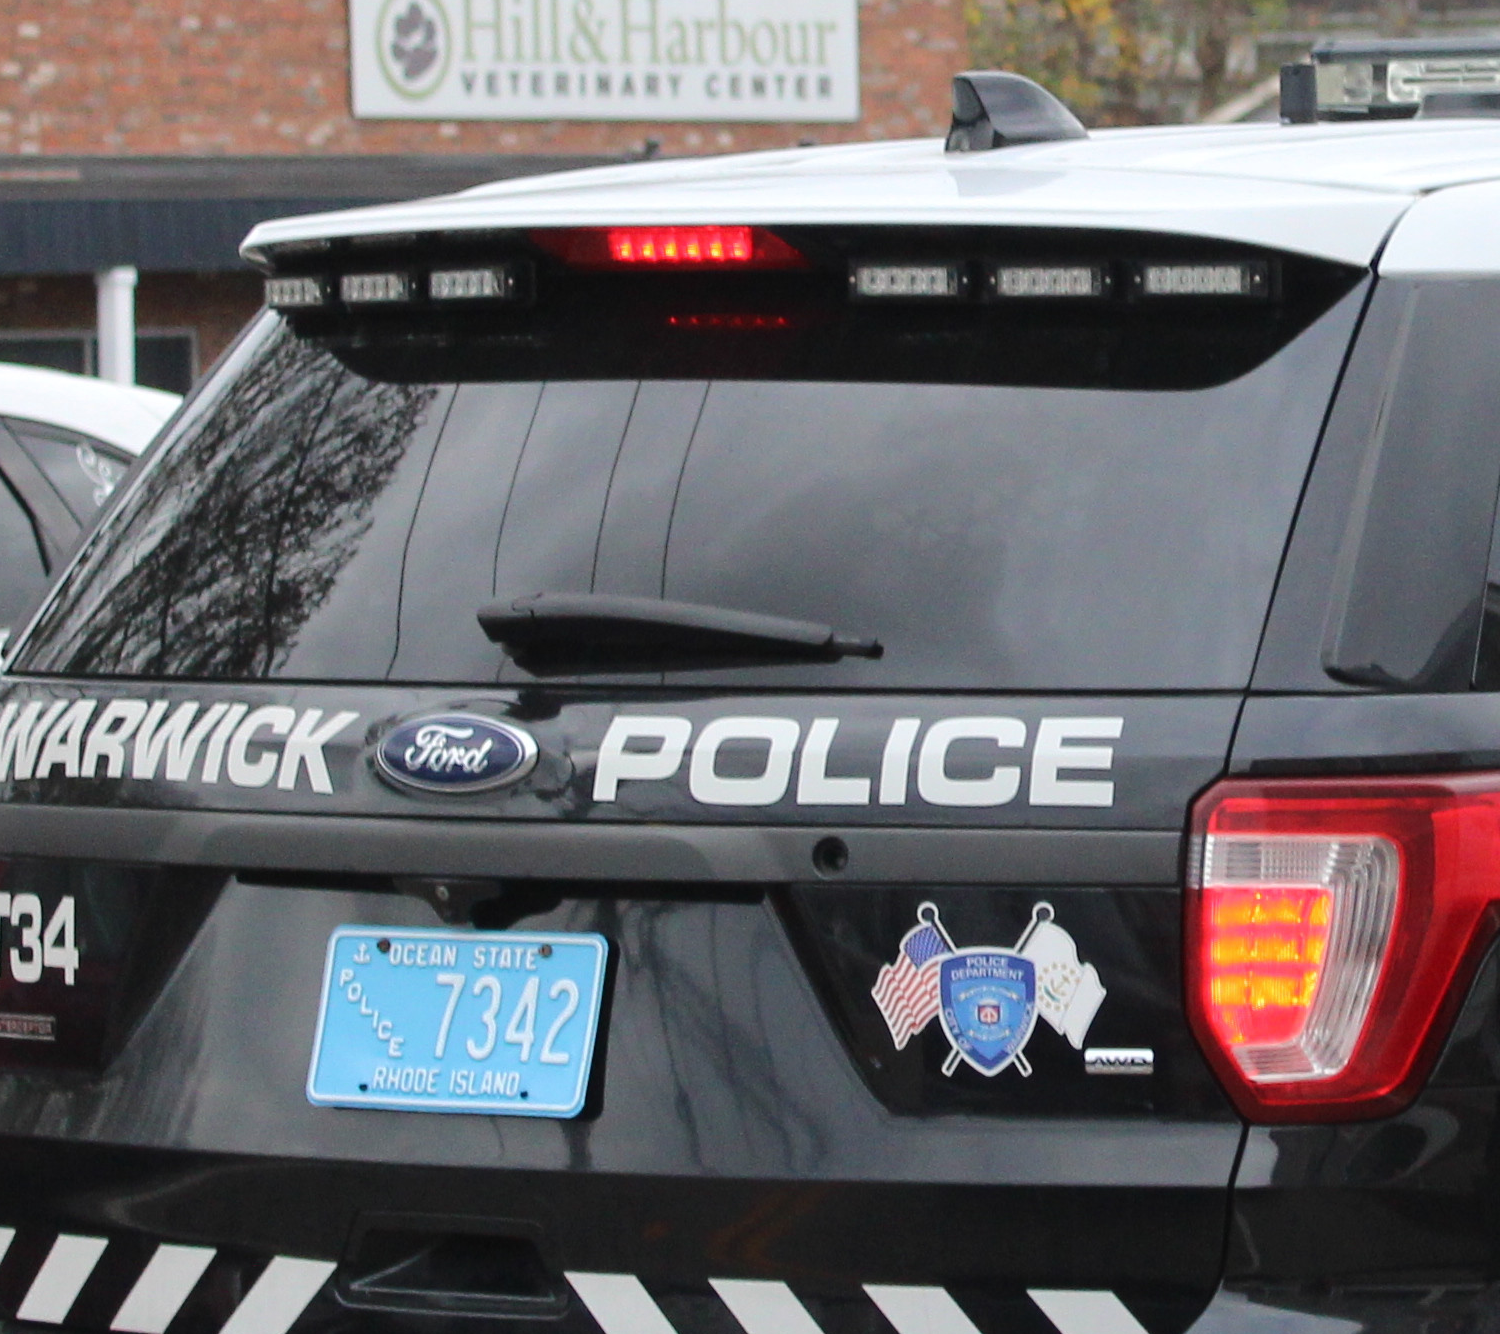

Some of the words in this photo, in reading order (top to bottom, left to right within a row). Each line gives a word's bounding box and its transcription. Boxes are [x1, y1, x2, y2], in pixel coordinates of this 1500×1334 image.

[461, 72, 683, 99] VETERINARY
[704, 72, 835, 100] CENTER
[405, 723, 492, 774] Ford
[592, 715, 1124, 807] POLICE
[389, 943, 457, 967] OCEAN
[473, 947, 539, 970] STATE
[966, 956, 1008, 967] POLICE
[951, 968, 1024, 981] DEPARTMENT
[339, 969, 404, 1058] POLICE
[434, 973, 579, 1064] 7342
[372, 1067, 440, 1094] RHODE
[450, 1069, 520, 1096] ISLAND
